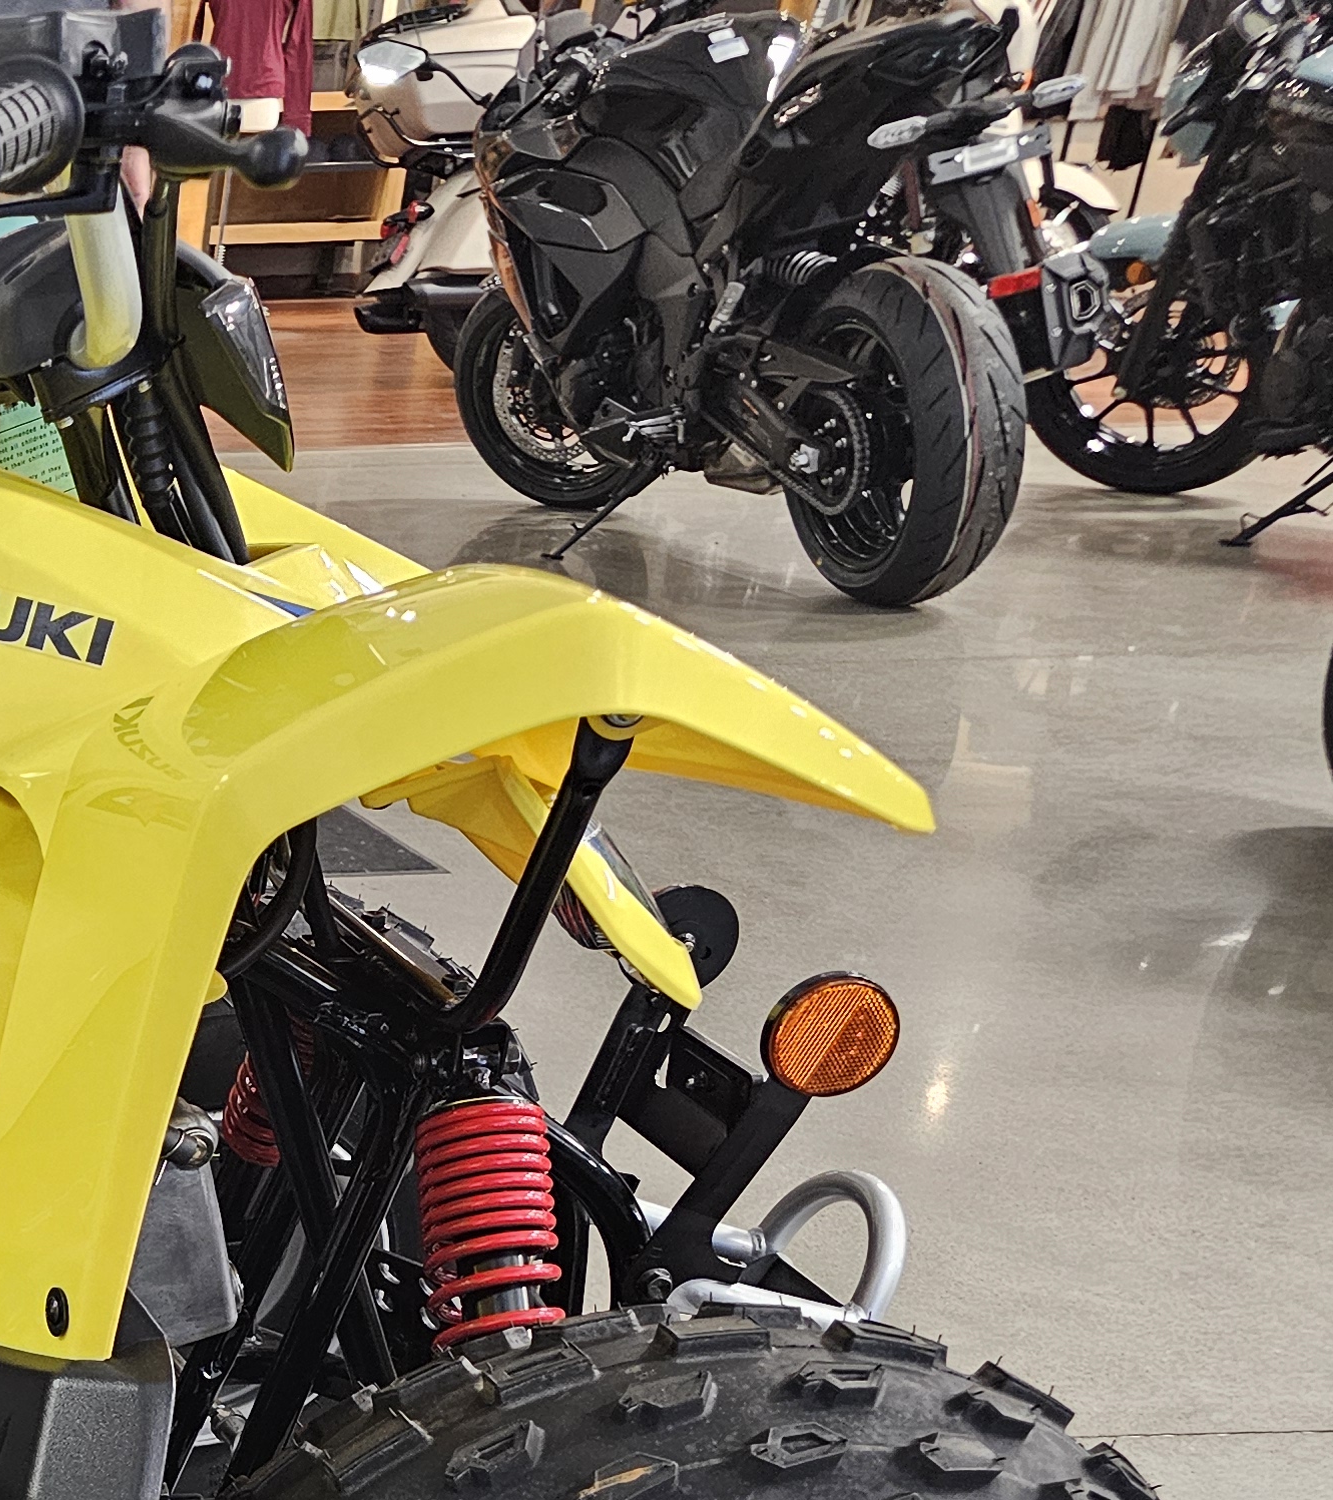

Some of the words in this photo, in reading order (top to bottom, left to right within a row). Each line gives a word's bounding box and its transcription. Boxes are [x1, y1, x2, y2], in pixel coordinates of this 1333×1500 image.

[21, 433, 47, 447] children
[25, 442, 49, 455] operate
[10, 459, 25, 470] their
